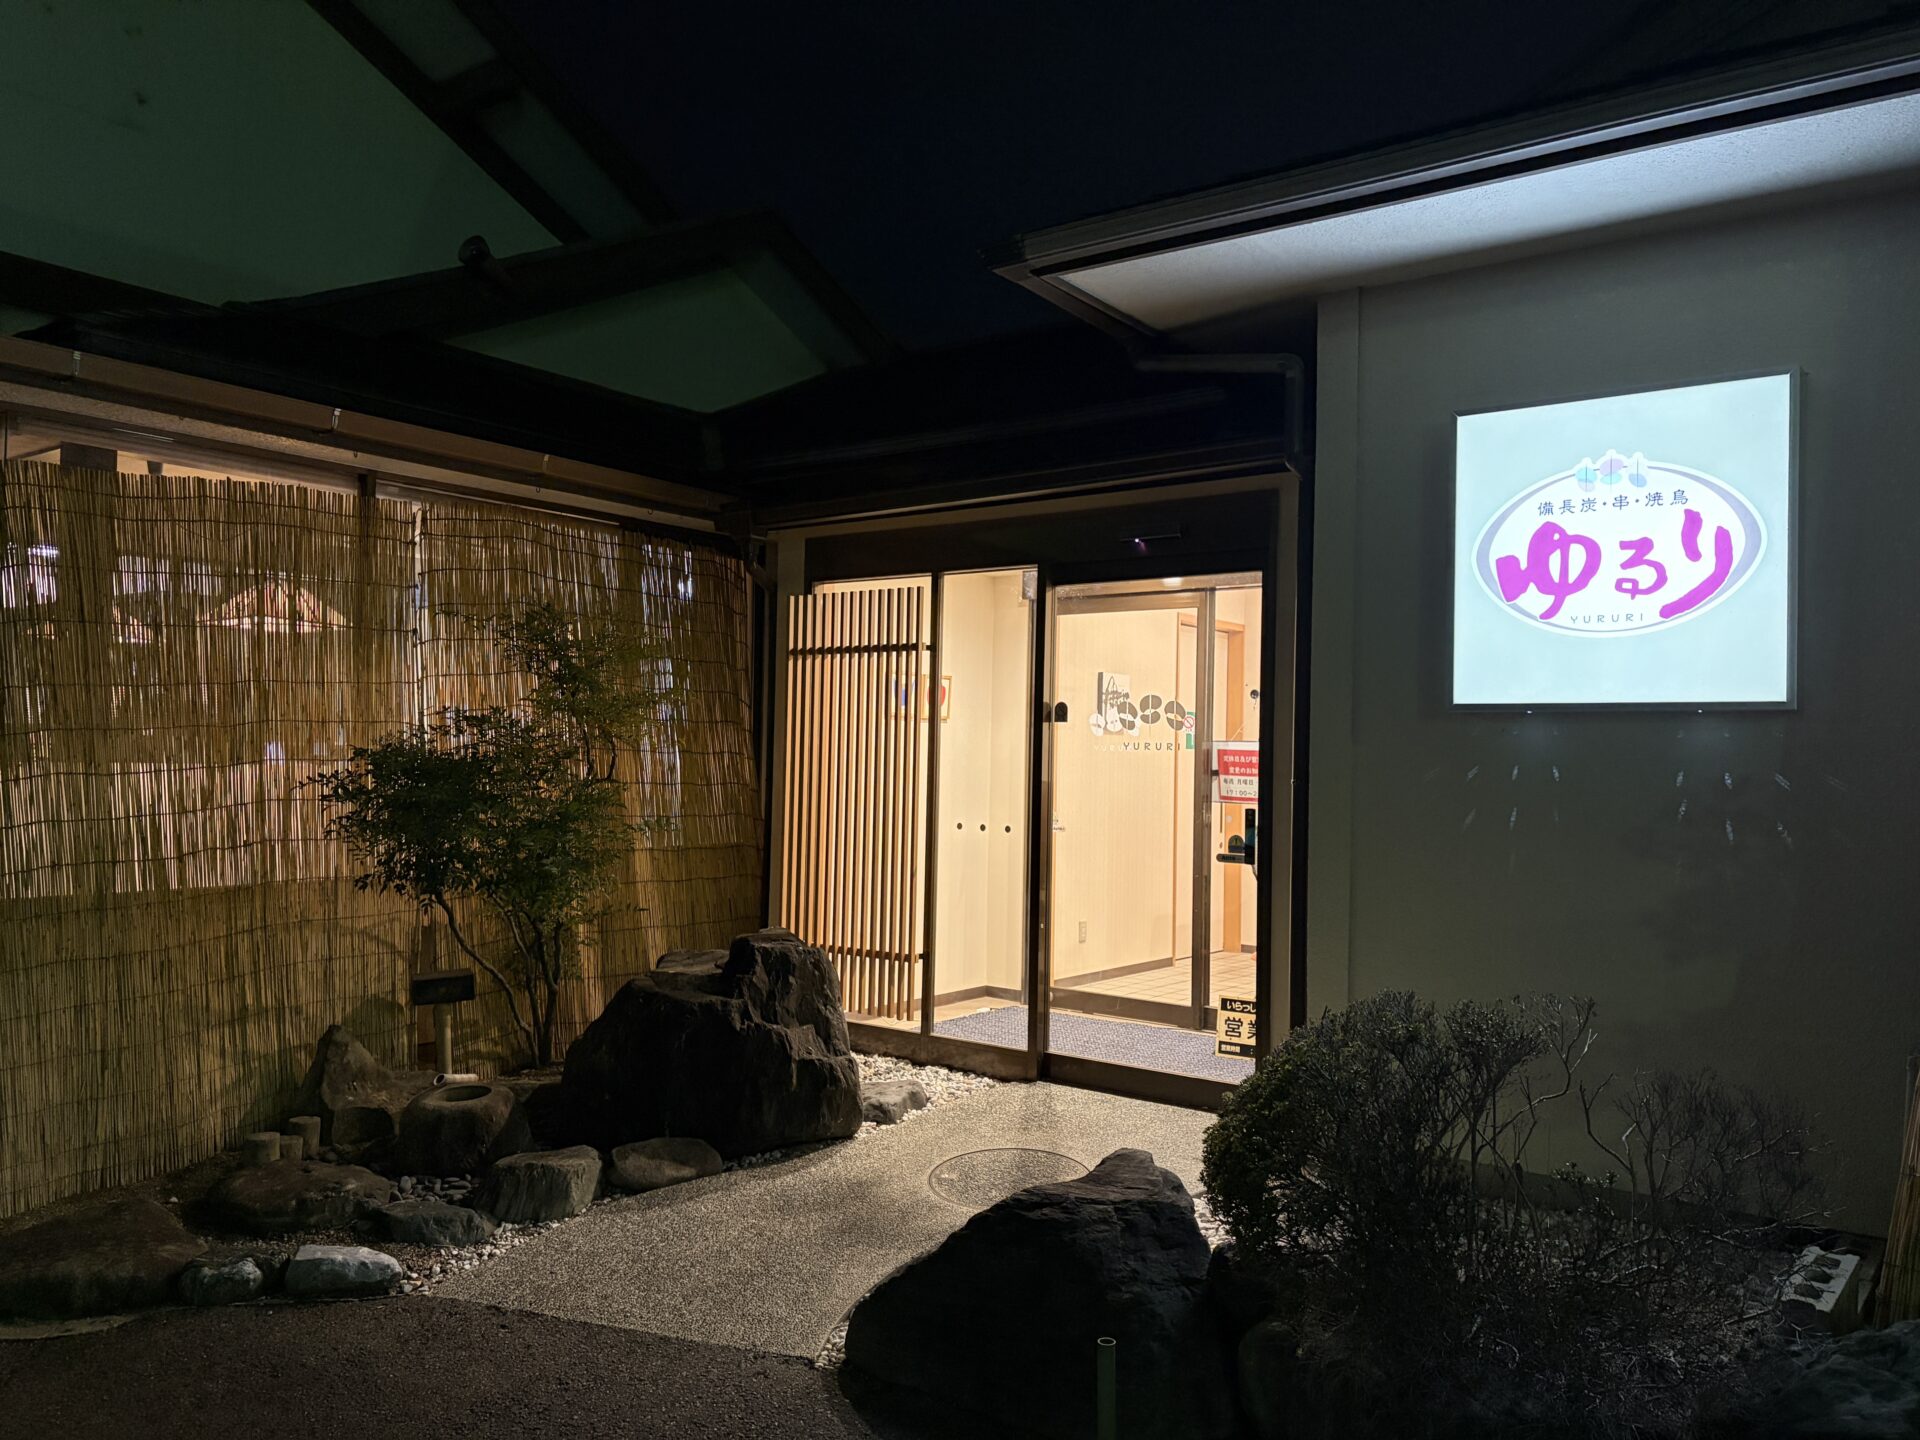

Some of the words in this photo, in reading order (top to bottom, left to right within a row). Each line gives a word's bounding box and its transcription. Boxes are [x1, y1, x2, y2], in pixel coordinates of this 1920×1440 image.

[1496, 508, 1733, 620] ゆるり
[1570, 613, 1644, 624] YURURI
[1122, 742, 1181, 751] YURURI
